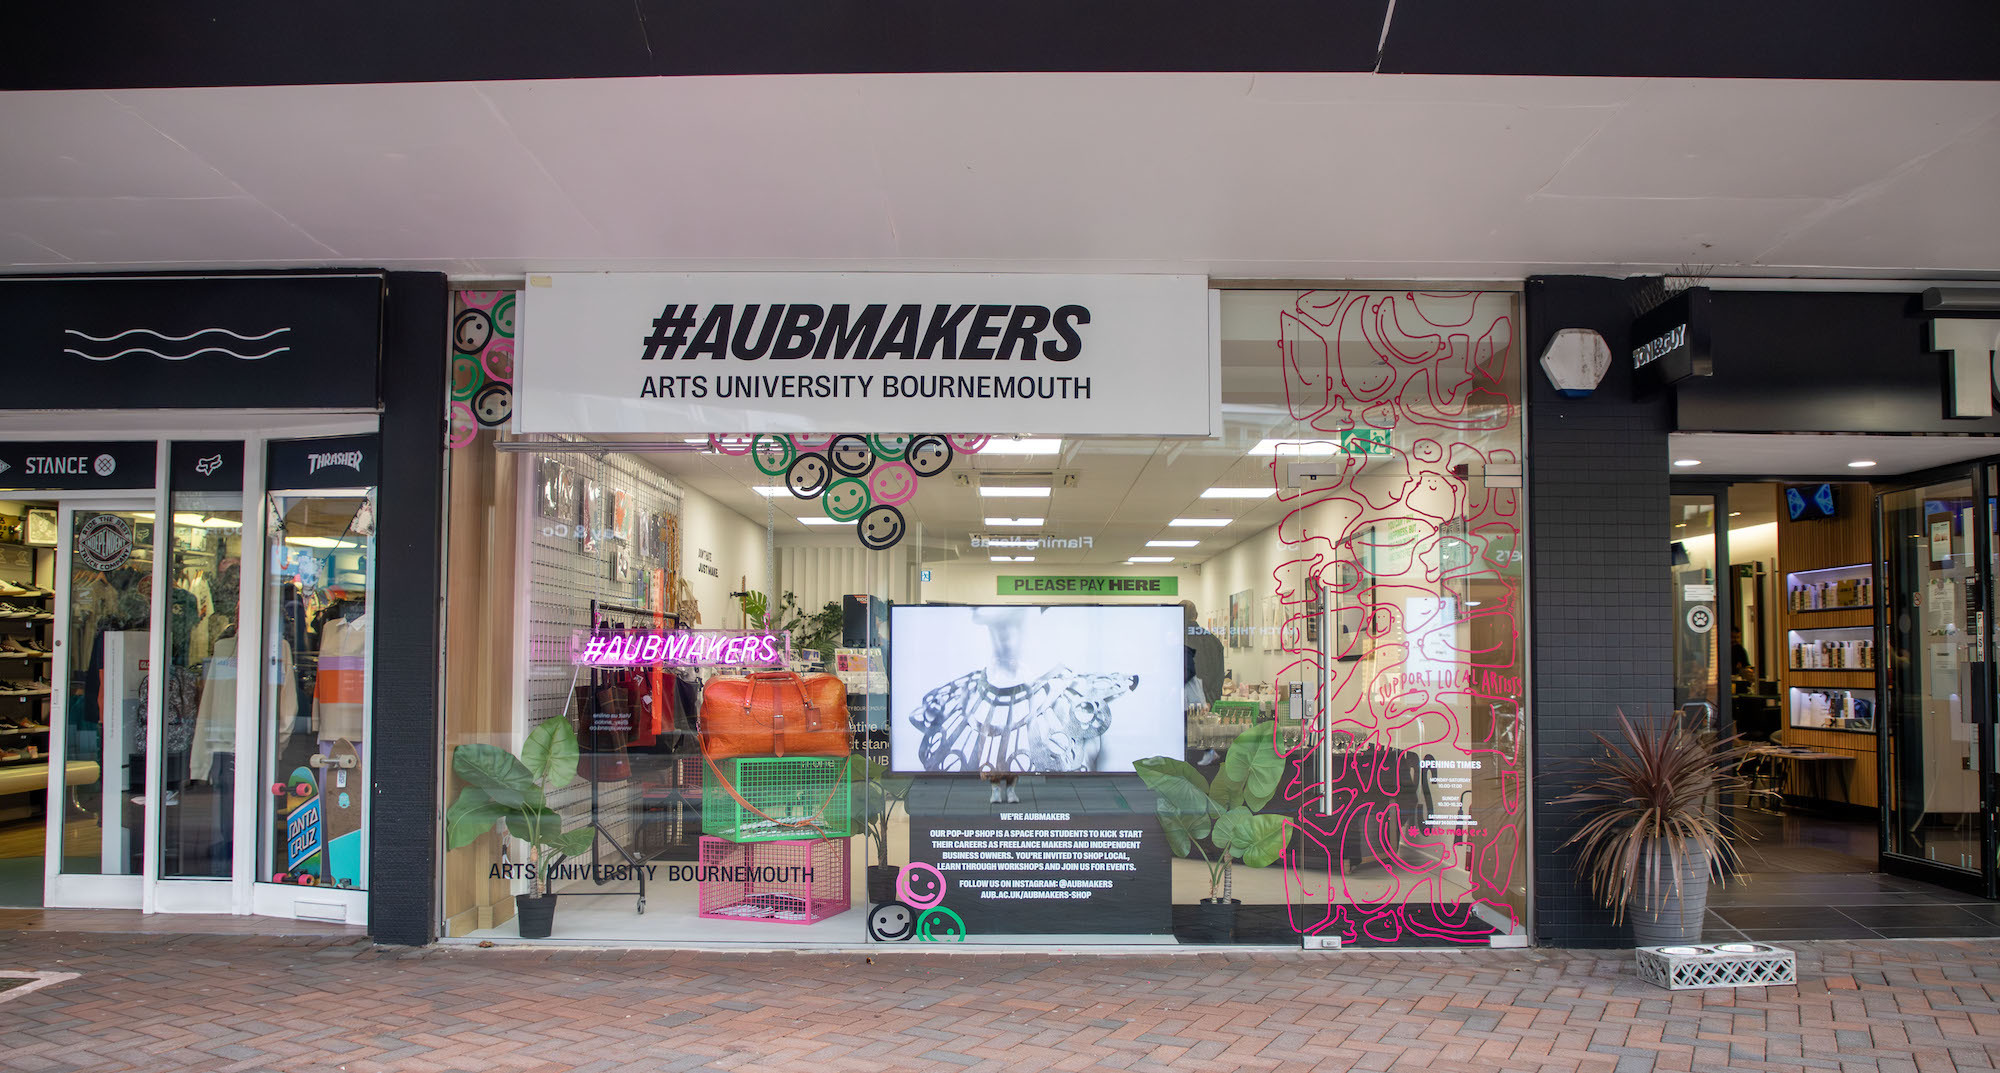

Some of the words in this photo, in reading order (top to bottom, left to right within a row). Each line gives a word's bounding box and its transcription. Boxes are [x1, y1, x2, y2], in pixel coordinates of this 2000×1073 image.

[641, 304, 1091, 361] #AUBMAKERS
[1632, 323, 1687, 370] TONI&GUY
[640, 376, 708, 398] ARTS
[716, 376, 874, 398] UNIVERSITY
[883, 375, 1091, 399] BOURNEMOUTH
[25, 456, 89, 475] STANCE
[307, 450, 364, 475] THRASHER
[1014, 579, 1077, 591] PLEASE
[1080, 579, 1105, 591] PAY
[1109, 579, 1161, 591] HERE
[1975, 612, 1984, 662] PUSH
[583, 634, 778, 664] #AUBMAKERS
[1380, 670, 1432, 706] SUPPORT
[1438, 668, 1478, 689] LOCAL
[1481, 669, 1523, 697] ARTISTS
[1420, 760, 1455, 769] OPENING
[1456, 760, 1482, 769] TIMES
[287, 806, 319, 842] SANTA
[1000, 812, 1023, 821] WE'RE
[1024, 812, 1071, 821] AUBMAKERS
[289, 826, 317, 860] CRUZ
[930, 829, 945, 838] OUR
[946, 829, 975, 838] POP-UP
[975, 829, 995, 838] SHOP
[996, 829, 1003, 838] IS
[1004, 829, 1009, 838] A
[1010, 829, 1034, 838] SPACE
[1035, 829, 1049, 838] FOR
[1050, 829, 1088, 838] STUDENTS
[1089, 829, 1100, 838] TO
[1100, 829, 1117, 838] KICK
[1119, 829, 1143, 838] START
[932, 840, 953, 849] THEIR
[954, 840, 987, 849] CAREERS
[988, 840, 998, 849] AS
[999, 840, 1040, 849] FREELANCE
[1041, 840, 1072, 849] MAKERS
[1073, 840, 1089, 849] AND
[1090, 840, 1141, 849] INDEPENDENT
[942, 851, 979, 860] BUSINESS
[980, 851, 1014, 860] OWNERS.
[1016, 851, 1042, 860] YOU'RE
[1043, 851, 1072, 860] INVITED
[1073, 851, 1083, 860] TO
[1083, 851, 1103, 860] SHOP
[1104, 851, 1131, 860] LOCAL,
[489, 863, 536, 880] ARTS
[547, 863, 658, 881] UNIVERSITY
[668, 864, 814, 883] BOURNEMOUTH
[937, 863, 961, 871] LEARN
[962, 863, 996, 871] THROUGH
[998, 863, 1044, 871] WORKSHOPS
[1045, 863, 1062, 871] AND
[1062, 863, 1079, 871] JOIN
[1079, 863, 1090, 871] US
[1091, 863, 1105, 871] FOR
[1106, 863, 1136, 871] EVENTS.
[959, 879, 989, 888] FOLLOW
[989, 879, 999, 888] US
[1001, 879, 1011, 888] ON
[1012, 879, 1058, 888] INSTAGRAM:
[1059, 879, 1113, 888] @AUBMAKERS
[980, 890, 1092, 899] AUB.AC.UK/AUBMAKERS-SHOP
